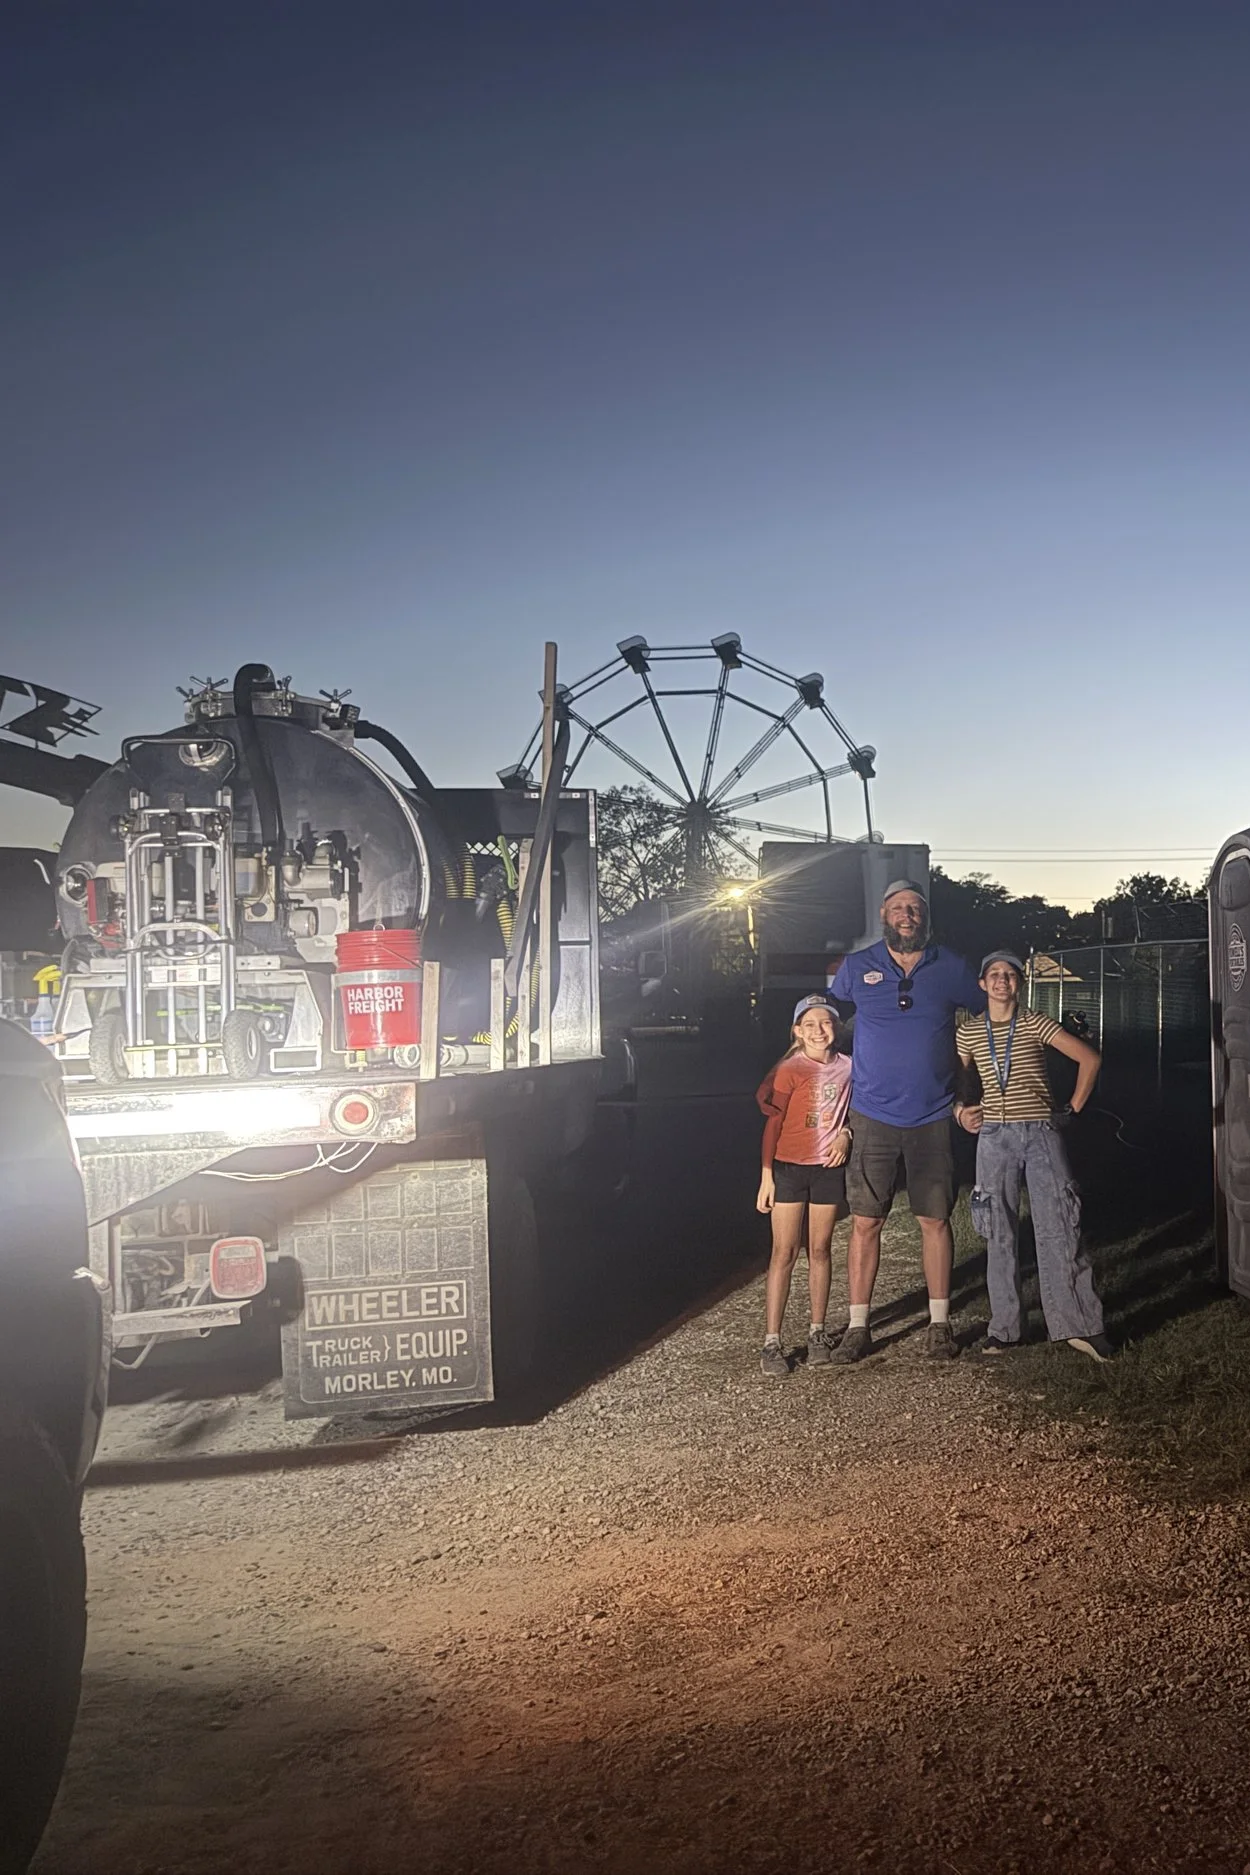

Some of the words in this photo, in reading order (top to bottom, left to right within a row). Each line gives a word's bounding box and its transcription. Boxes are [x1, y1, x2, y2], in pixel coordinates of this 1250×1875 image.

[347, 986, 404, 1001] HARBOR
[348, 999, 404, 1015] FREIGHT
[311, 1285, 461, 1325] WHEELER
[396, 1329, 468, 1361] EQUIP.
[422, 1366, 457, 1386] MO.
